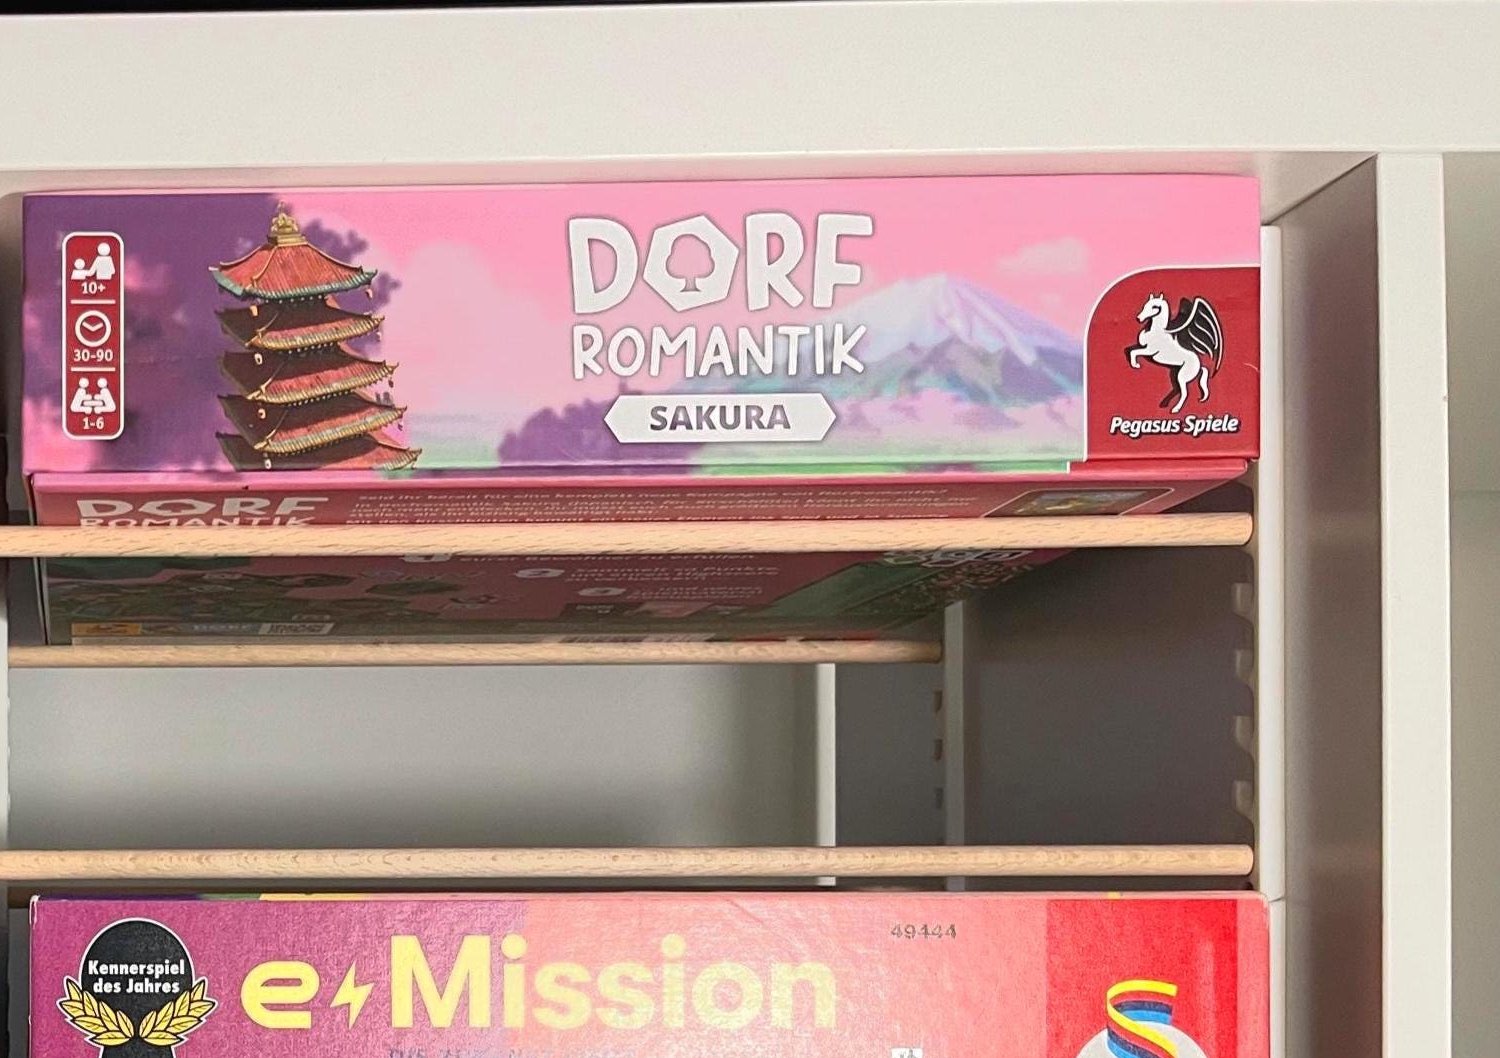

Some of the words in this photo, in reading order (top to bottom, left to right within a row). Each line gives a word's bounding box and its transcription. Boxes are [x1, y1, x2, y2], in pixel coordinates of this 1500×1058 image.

[568, 212, 874, 314] DORF
[81, 281, 106, 294] 10+
[73, 349, 113, 362] 30-90
[571, 323, 868, 380] ROMANTIK
[83, 416, 104, 430] 1-6
[650, 404, 791, 432] SAKURA
[1110, 416, 1180, 438] Pegasus
[1183, 414, 1239, 437] Spiele
[890, 923, 957, 940] 49444
[87, 960, 185, 977] Kennerspiel
[94, 977, 122, 994] des
[126, 977, 180, 995] Jahres
